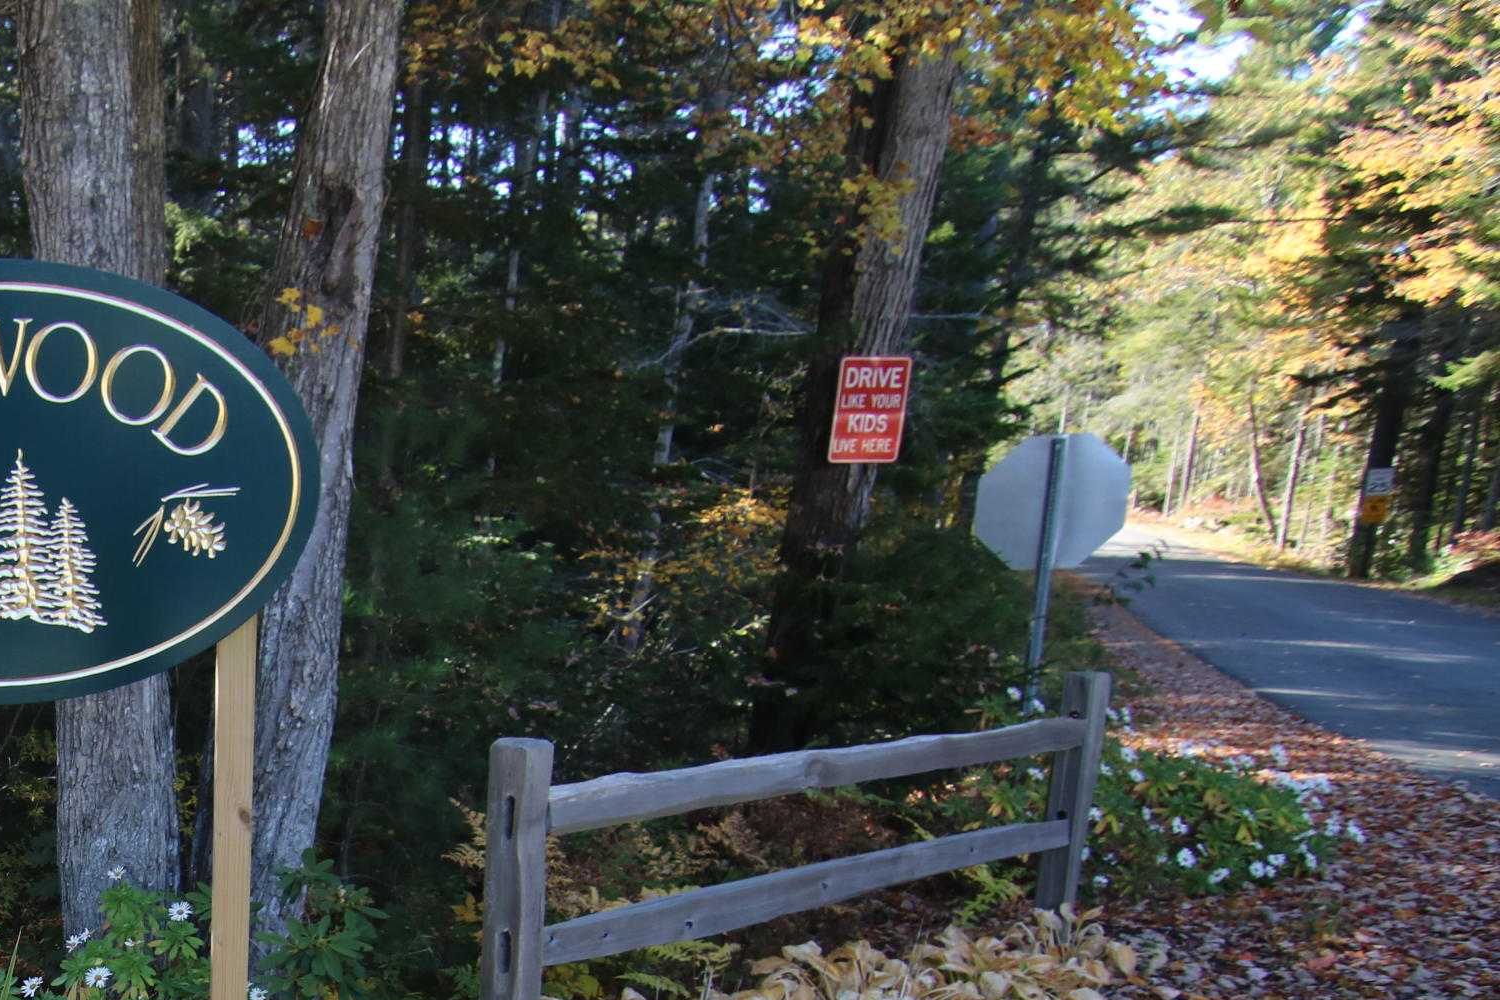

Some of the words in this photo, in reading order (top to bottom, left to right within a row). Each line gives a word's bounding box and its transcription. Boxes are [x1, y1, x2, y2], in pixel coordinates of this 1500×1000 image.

[845, 366, 904, 388] DRIVE
[841, 394, 867, 409] LIKE
[871, 394, 902, 409] YOUR
[847, 413, 888, 433] KIDS
[833, 438, 858, 453] LIVE
